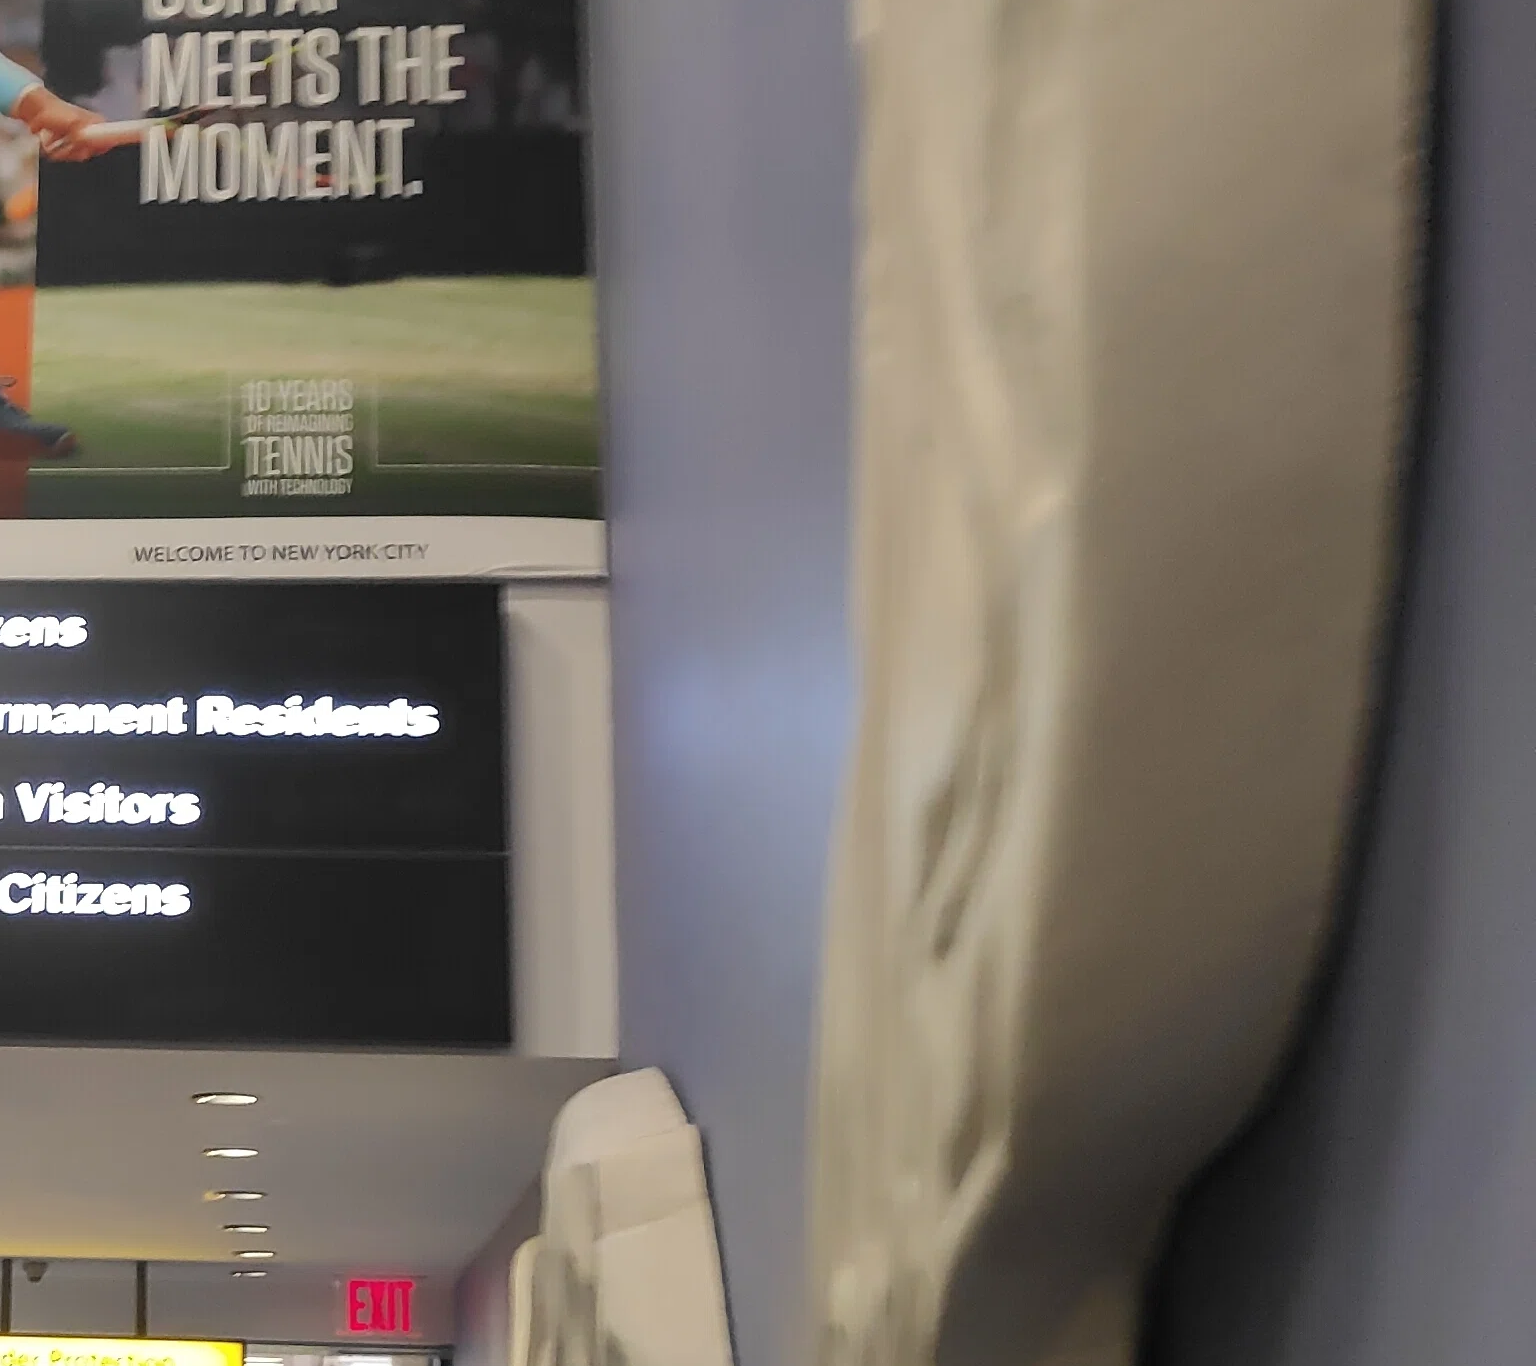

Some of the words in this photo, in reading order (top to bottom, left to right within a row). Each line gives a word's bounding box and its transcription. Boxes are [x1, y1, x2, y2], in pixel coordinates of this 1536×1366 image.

[141, 26, 341, 112] MEETS
[346, 23, 467, 107] THE
[140, 117, 423, 205] MOMENT.
[242, 379, 271, 414] 10
[279, 379, 354, 413] YEARS
[241, 435, 354, 478] TENNIS
[245, 479, 278, 496] WITH
[133, 544, 235, 564] WELCOME
[239, 544, 266, 563] TO
[271, 544, 323, 562] NEW
[325, 543, 379, 562] YORK
[381, 543, 431, 562] CITY
[195, 694, 440, 737] Residents
[14, 781, 201, 825] Visitors
[348, 1279, 415, 1332] EXIT
